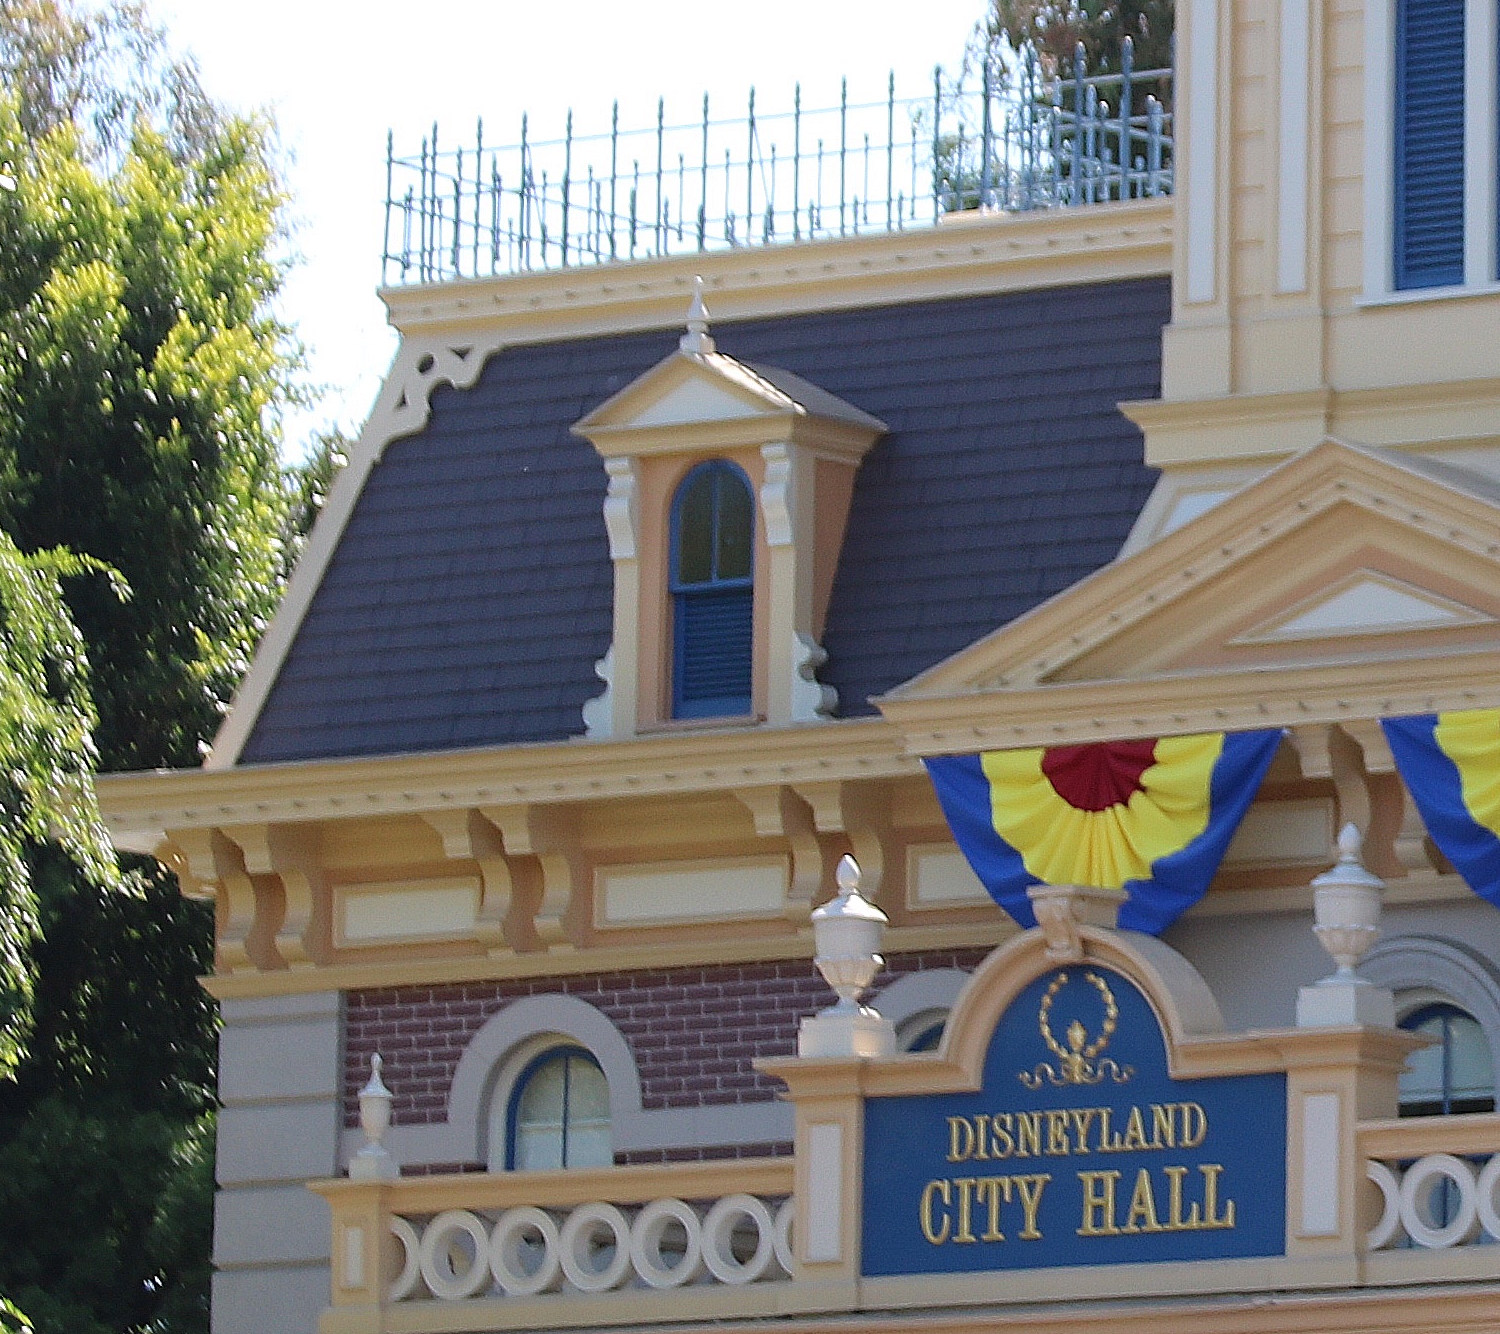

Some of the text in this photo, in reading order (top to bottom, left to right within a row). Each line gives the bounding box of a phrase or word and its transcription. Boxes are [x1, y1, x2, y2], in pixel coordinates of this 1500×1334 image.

[945, 1102, 1208, 1163] DISNEYLAND
[919, 1163, 1237, 1246] CITY HALL
